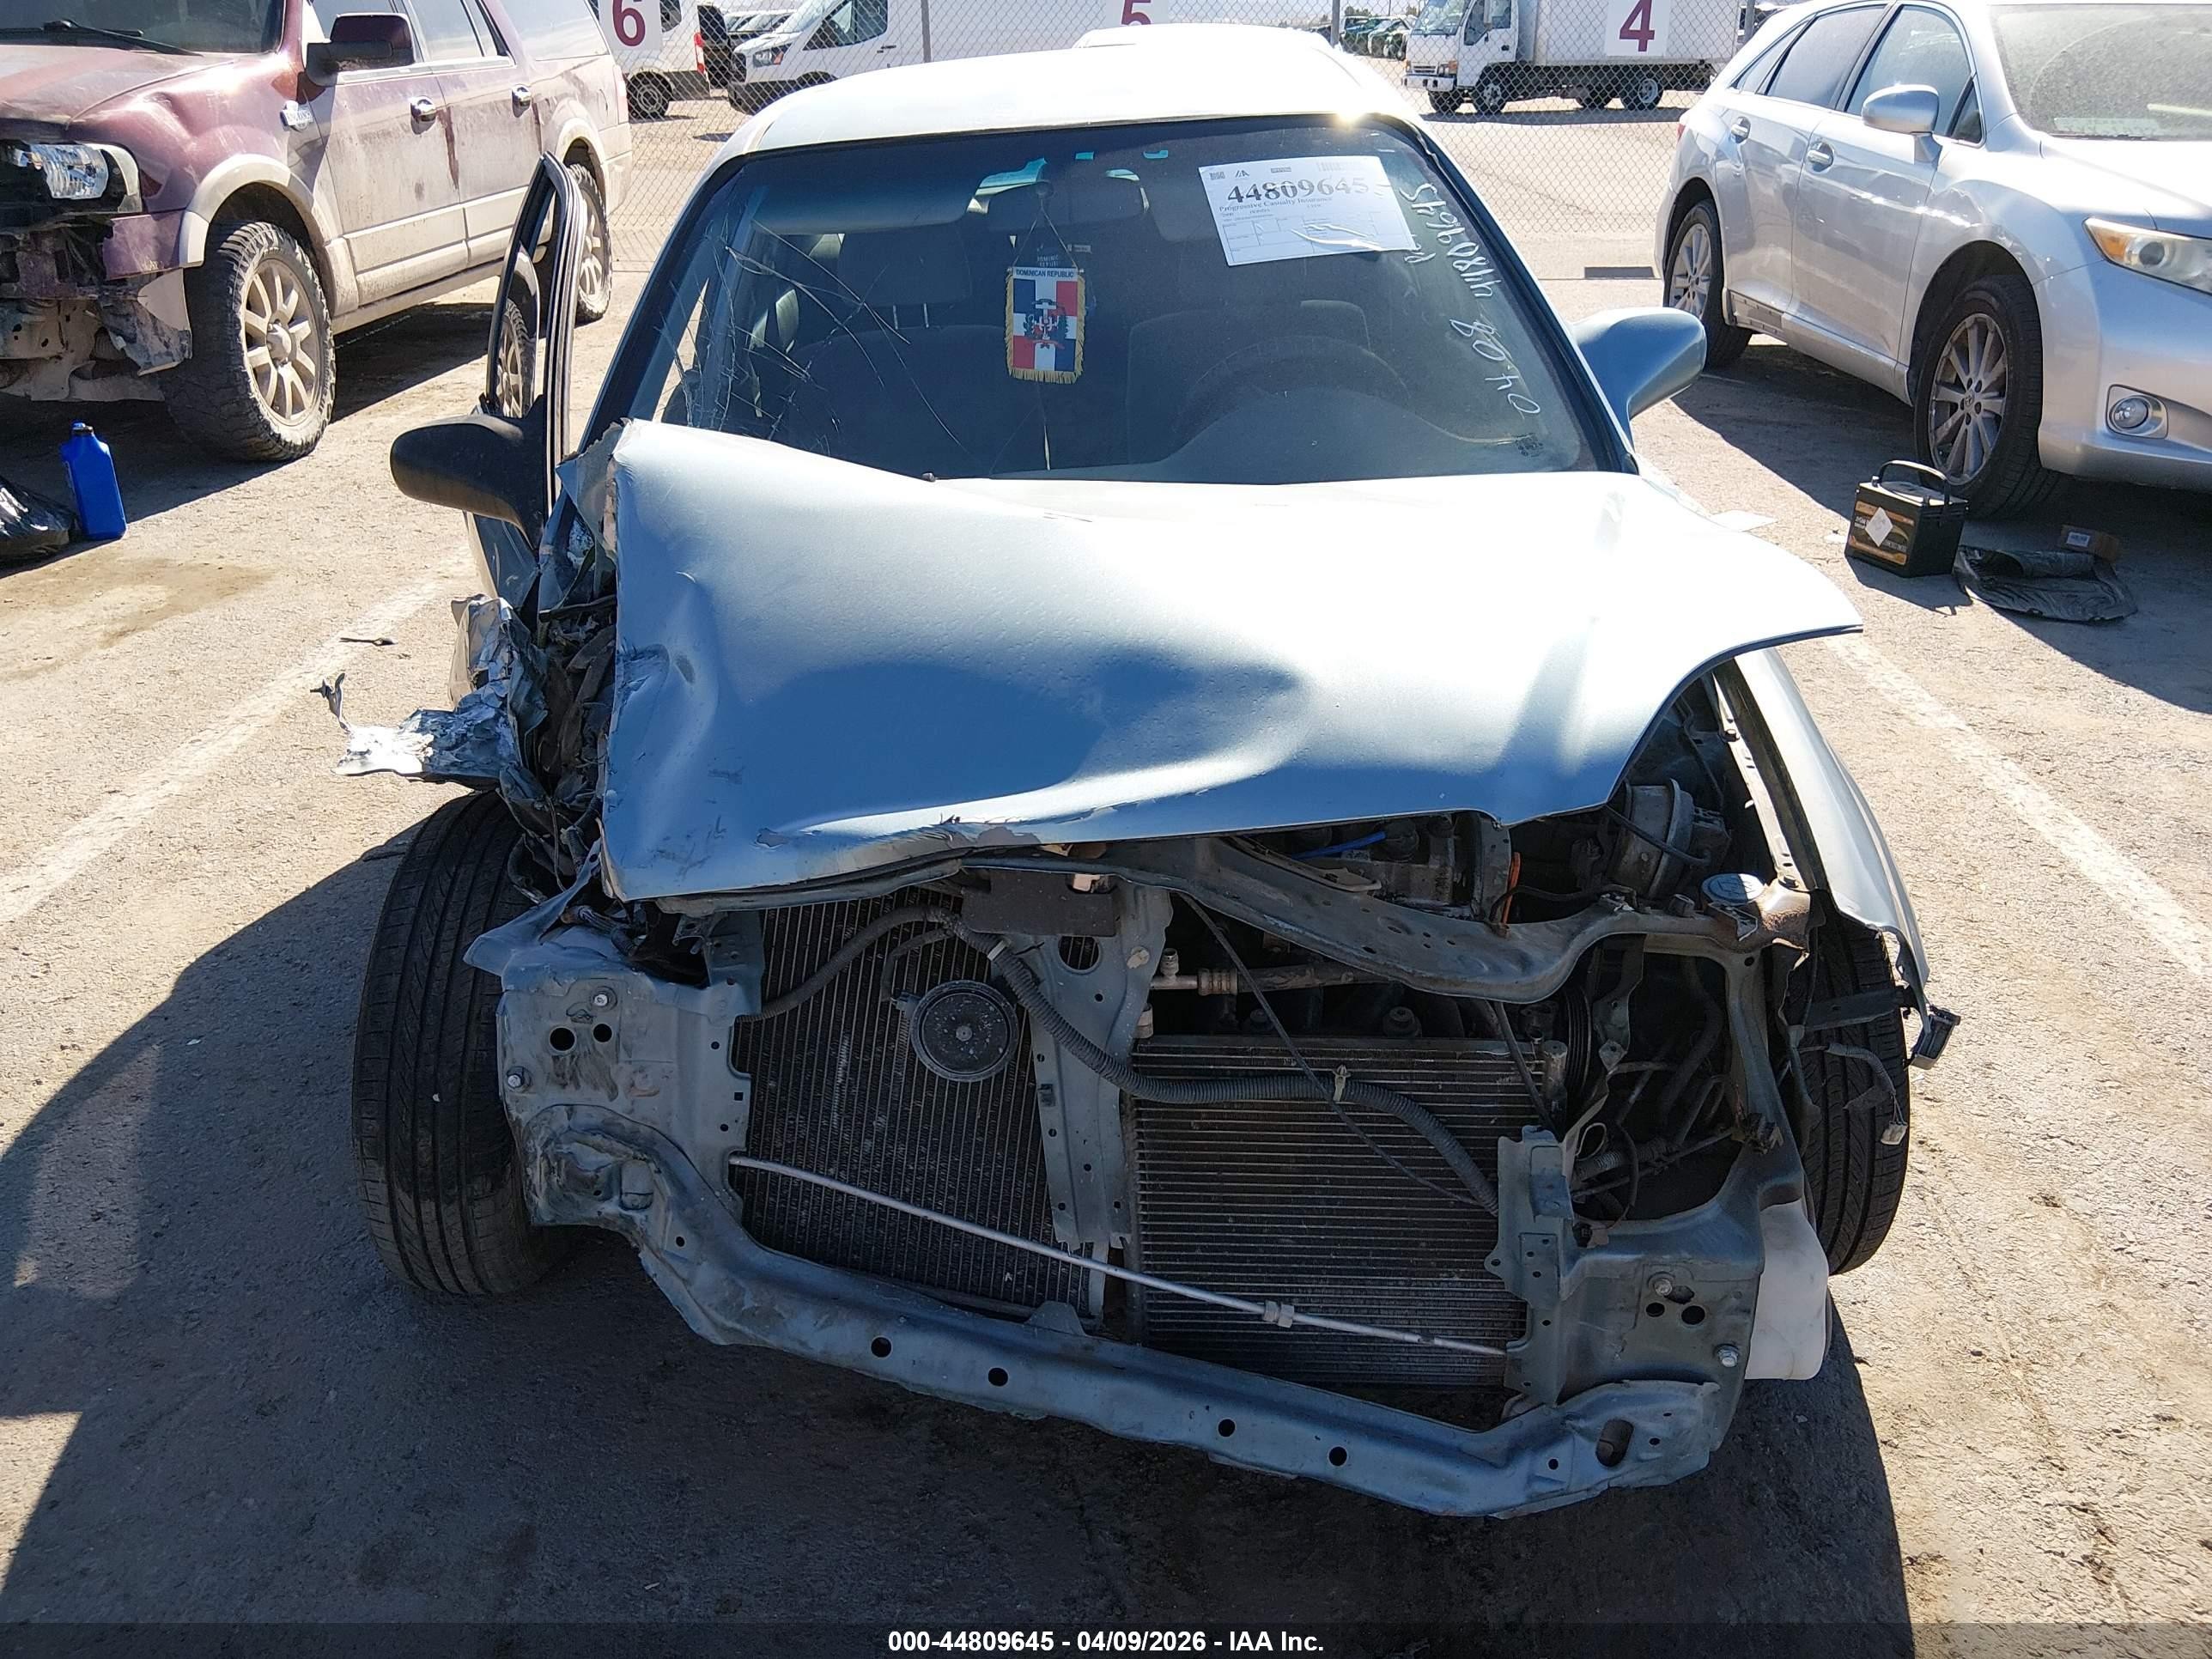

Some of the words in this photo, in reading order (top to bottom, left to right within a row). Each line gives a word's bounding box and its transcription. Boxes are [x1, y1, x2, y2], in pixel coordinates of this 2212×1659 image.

[612, 0, 646, 46] 6
[1121, 0, 1152, 25] 5
[1620, 0, 1656, 52] 4
[1227, 177, 1369, 204] 44809645
[1218, 201, 1262, 213] Progressive
[1263, 198, 1296, 209] Casualty
[1016, 268, 1047, 277] DOMINICAN
[1047, 269, 1074, 278] REPUBLIC
